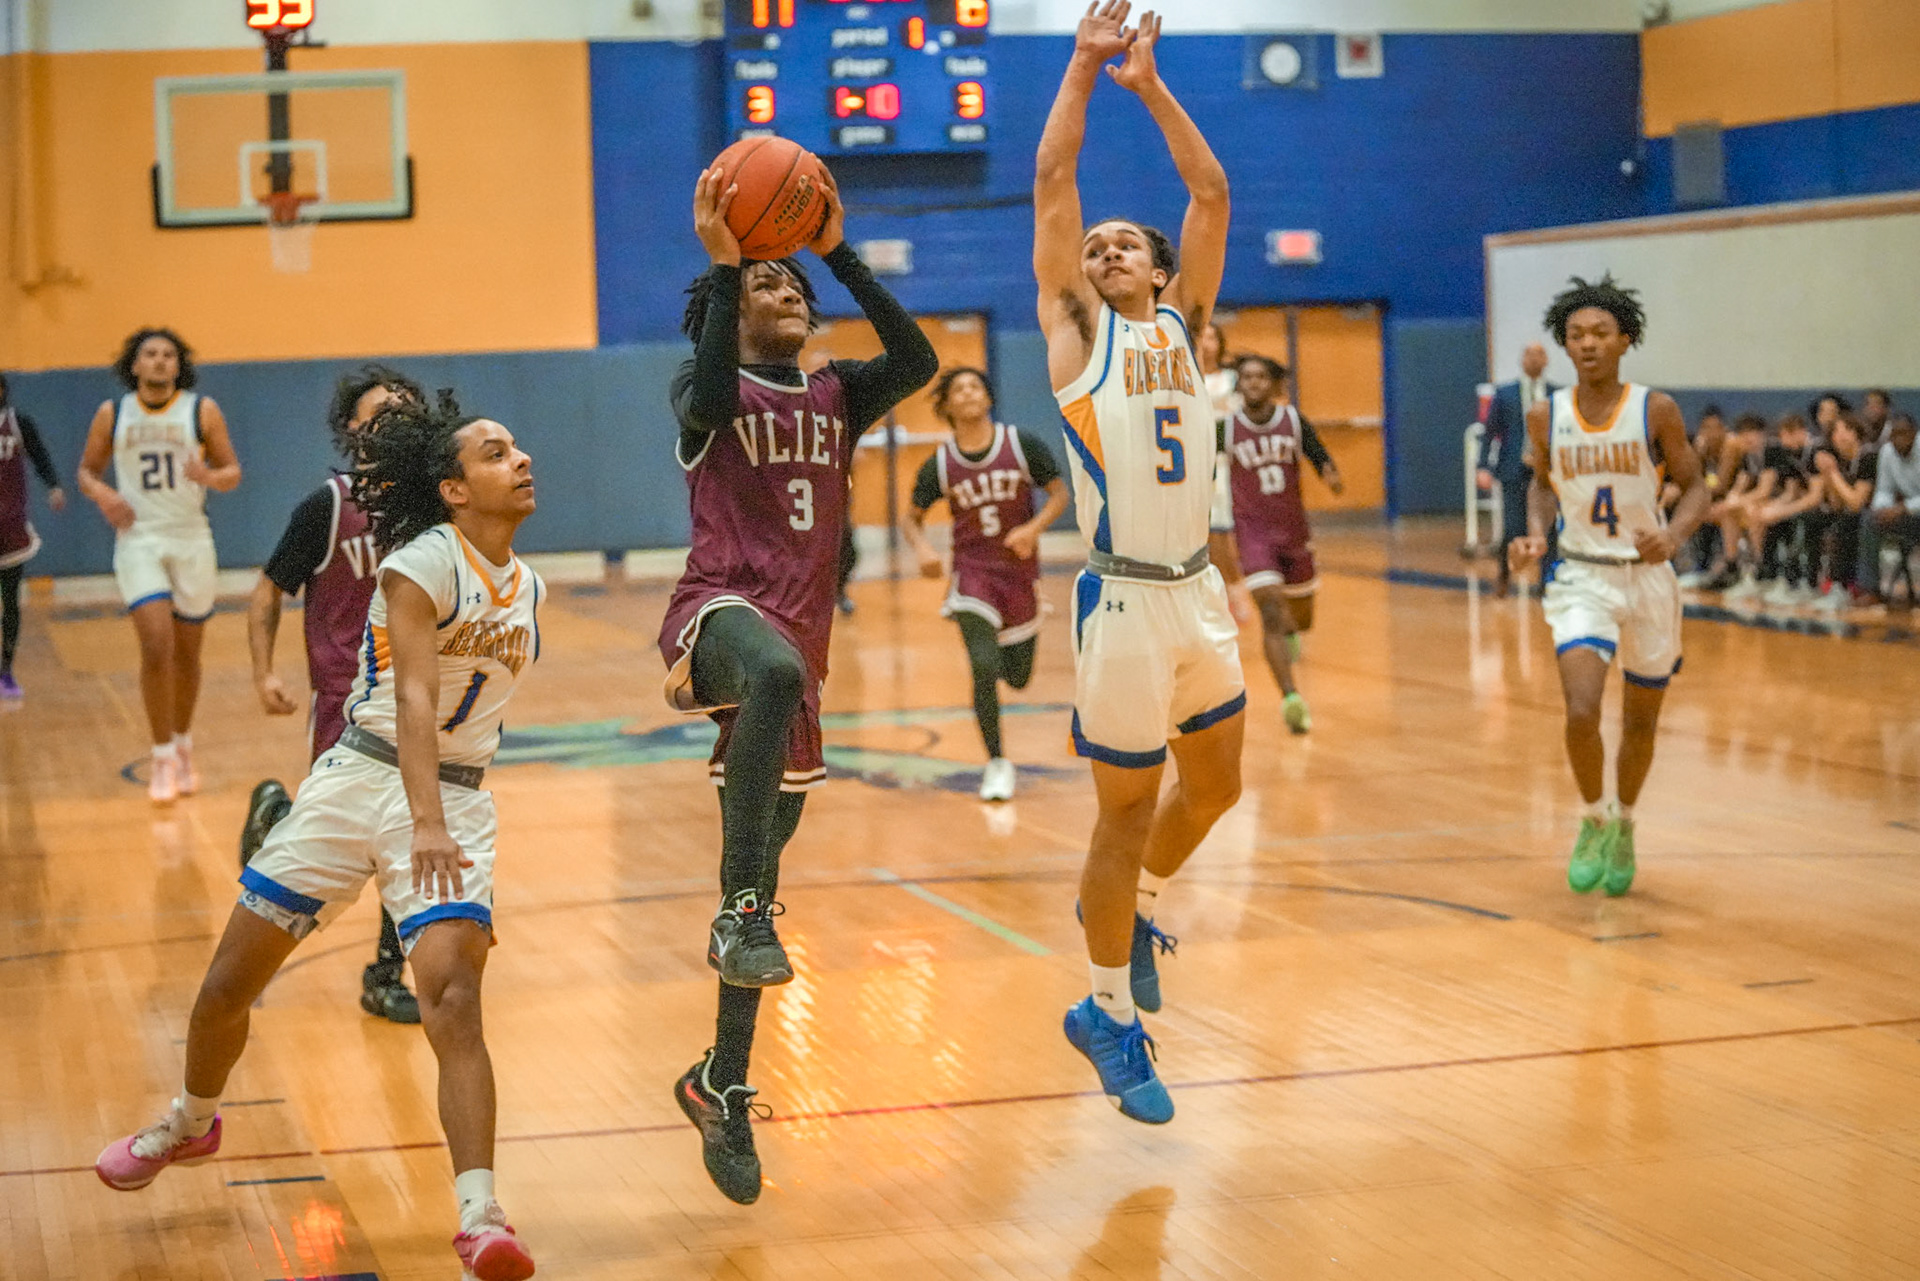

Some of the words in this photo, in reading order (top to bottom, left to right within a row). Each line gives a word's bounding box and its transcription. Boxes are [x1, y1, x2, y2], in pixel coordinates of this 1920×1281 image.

[747, 85, 775, 123] 3
[956, 81, 984, 118] 3
[1154, 405, 1186, 486] 5
[139, 450, 175, 490] 21
[787, 478, 814, 531] 3
[979, 504, 1001, 537] 5
[1590, 484, 1620, 538] 4
[438, 668, 488, 735] 1
